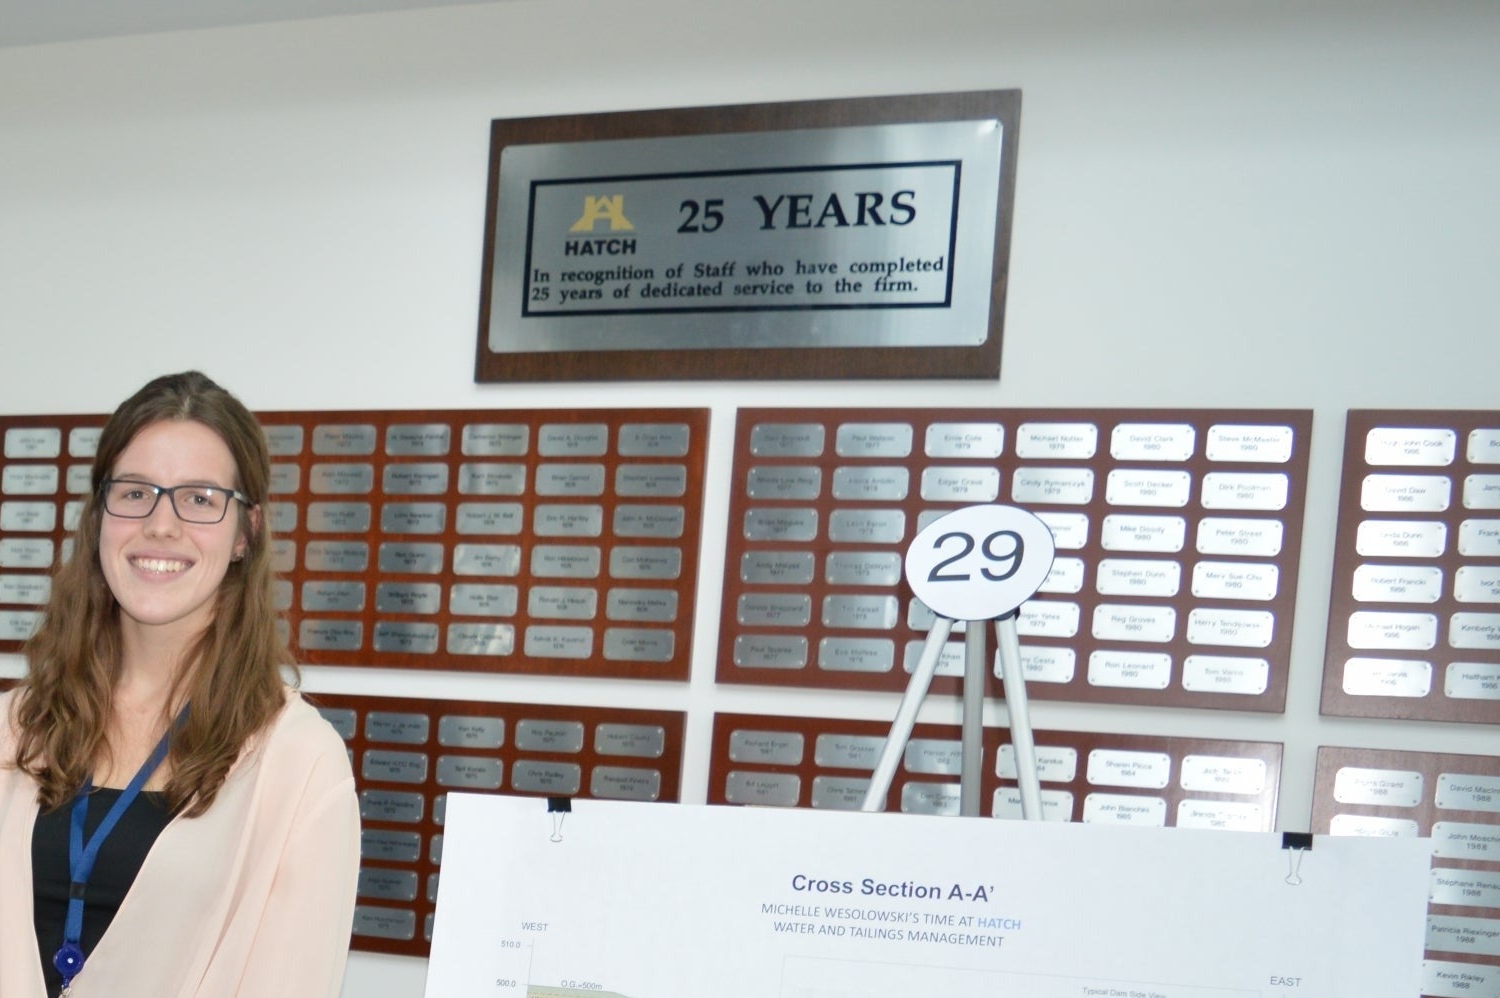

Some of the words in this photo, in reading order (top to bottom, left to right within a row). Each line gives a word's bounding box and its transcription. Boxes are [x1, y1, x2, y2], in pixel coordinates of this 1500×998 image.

[677, 199, 724, 234] 25
[753, 189, 916, 231] YEARS
[565, 239, 636, 256] HATCH
[534, 269, 551, 283] In
[561, 264, 654, 286] recognition
[666, 262, 684, 279] of
[694, 261, 736, 279] Staff
[746, 260, 784, 277] who
[795, 258, 838, 274] have
[849, 255, 944, 277] completed
[532, 286, 550, 302] 25
[559, 287, 602, 304] years
[612, 283, 630, 299] of
[640, 279, 723, 298] dedicated
[733, 280, 794, 296] service
[805, 280, 824, 295] to
[834, 276, 863, 293] the
[874, 276, 919, 293] firm.
[927, 529, 1025, 583] 29
[1471, 793, 1492, 802] 1988
[1466, 842, 1488, 850] 1988
[791, 875, 854, 894] Cross
[860, 879, 942, 899] Section
[521, 922, 548, 931] WEST
[761, 903, 820, 917] MICHELLE
[823, 907, 919, 923] WESOLOWSKI'S
[922, 914, 954, 926] TIME
[957, 916, 973, 927] AT
[976, 917, 1021, 930] HATCH
[772, 921, 815, 934] WATER
[817, 924, 845, 936] AND
[848, 926, 903, 940] TAILINGS
[907, 930, 1004, 947] MANAGEMENT
[1082, 987, 1108, 996] Typical
[1110, 989, 1128, 997] Dam
[1269, 976, 1302, 986] EAST
